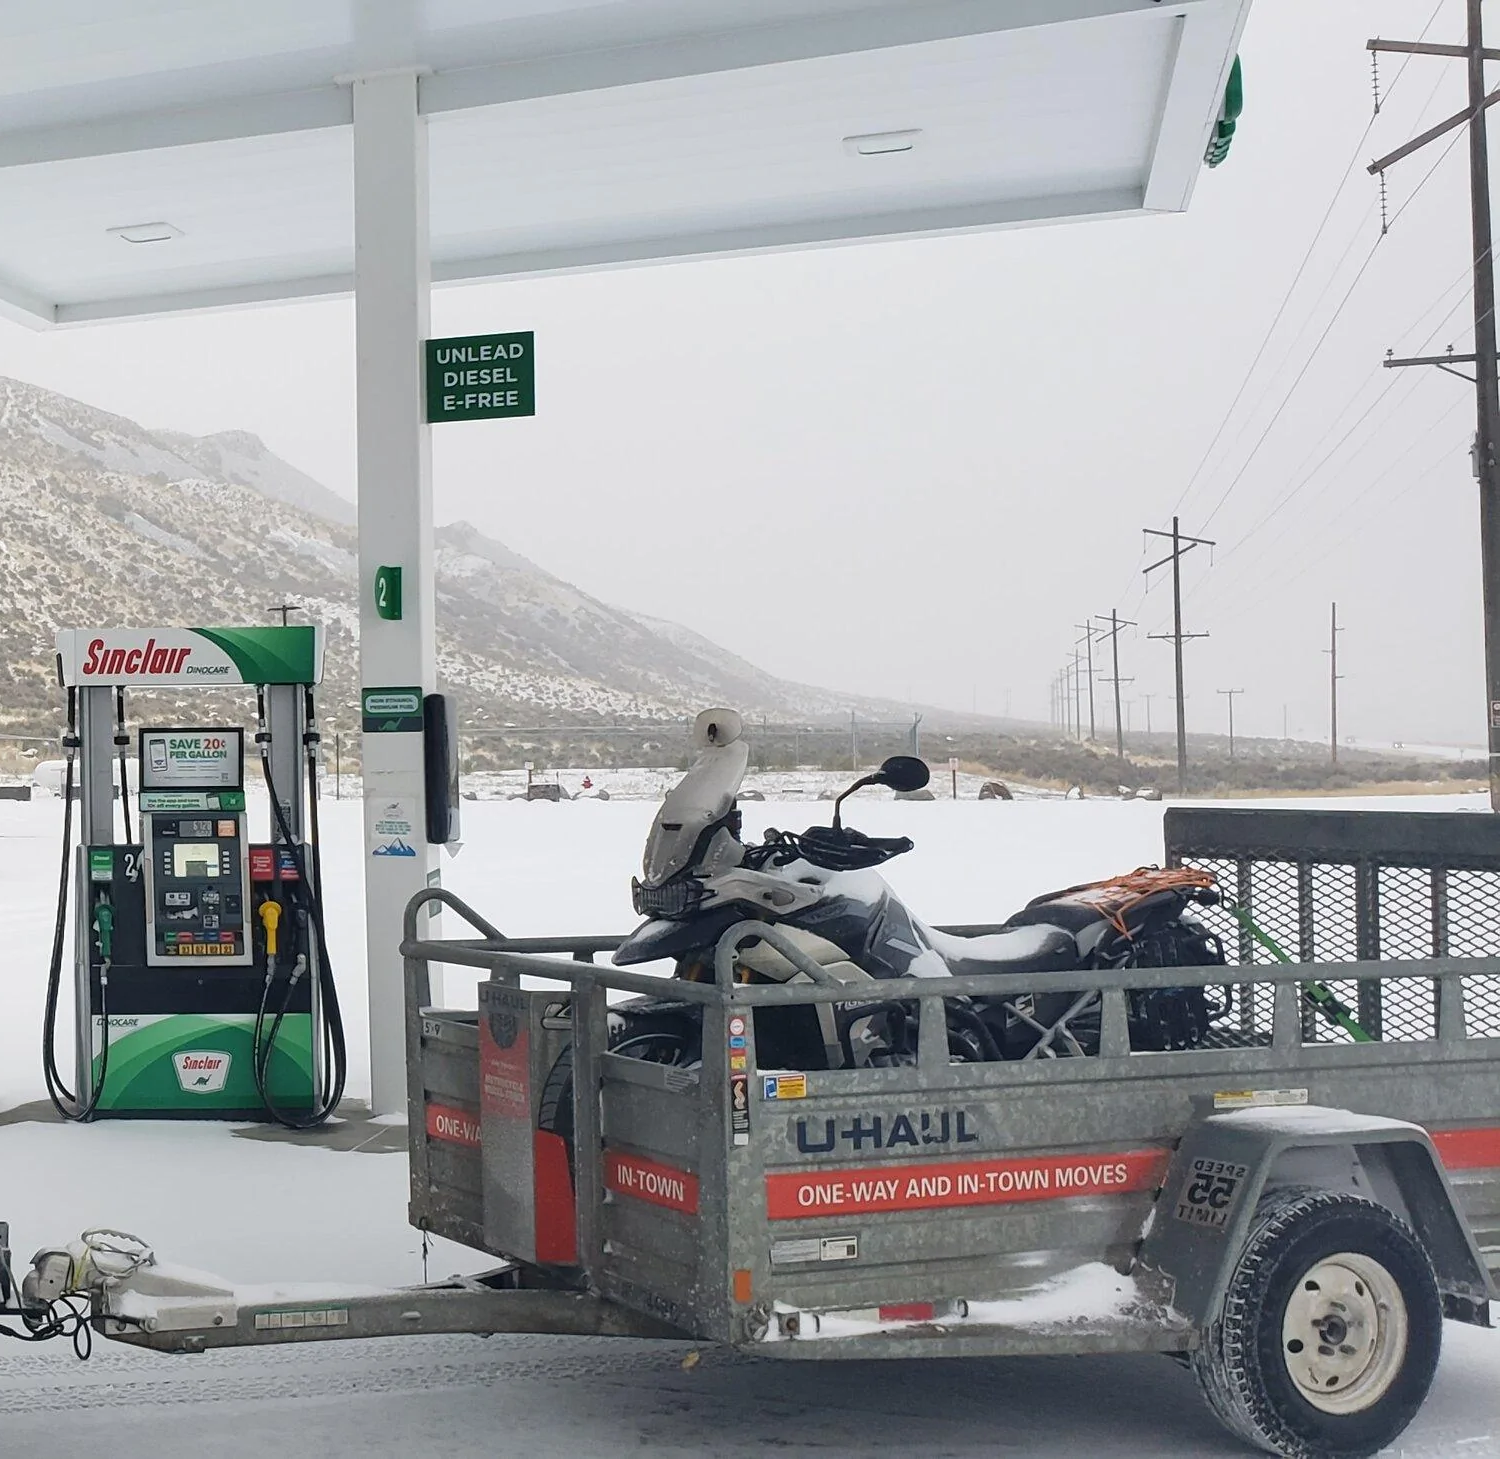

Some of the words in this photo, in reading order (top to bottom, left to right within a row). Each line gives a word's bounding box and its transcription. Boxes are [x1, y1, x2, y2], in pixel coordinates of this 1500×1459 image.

[436, 343, 524, 365] UNLEAD
[443, 367, 518, 388] DIESEL
[443, 390, 519, 411] E-FREE
[378, 577, 387, 608] 2
[83, 638, 192, 675] Sinclair
[186, 666, 232, 674] DINOCARE
[169, 739, 201, 749] SAVE
[169, 750, 187, 759] PER
[189, 750, 227, 759] GALLON
[124, 853, 137, 876] 2
[96, 1018, 139, 1026] DNOCARE
[182, 1056, 222, 1070] Sinclair
[436, 1114, 482, 1142] ONE-WA
[796, 1111, 980, 1154] U-HAUL
[617, 1164, 684, 1202] IN-TOWN
[798, 1179, 900, 1207] ONE-WAY
[906, 1176, 951, 1200] AND
[957, 1169, 1049, 1196] IN-TOWN
[1055, 1163, 1128, 1189] MOVES
